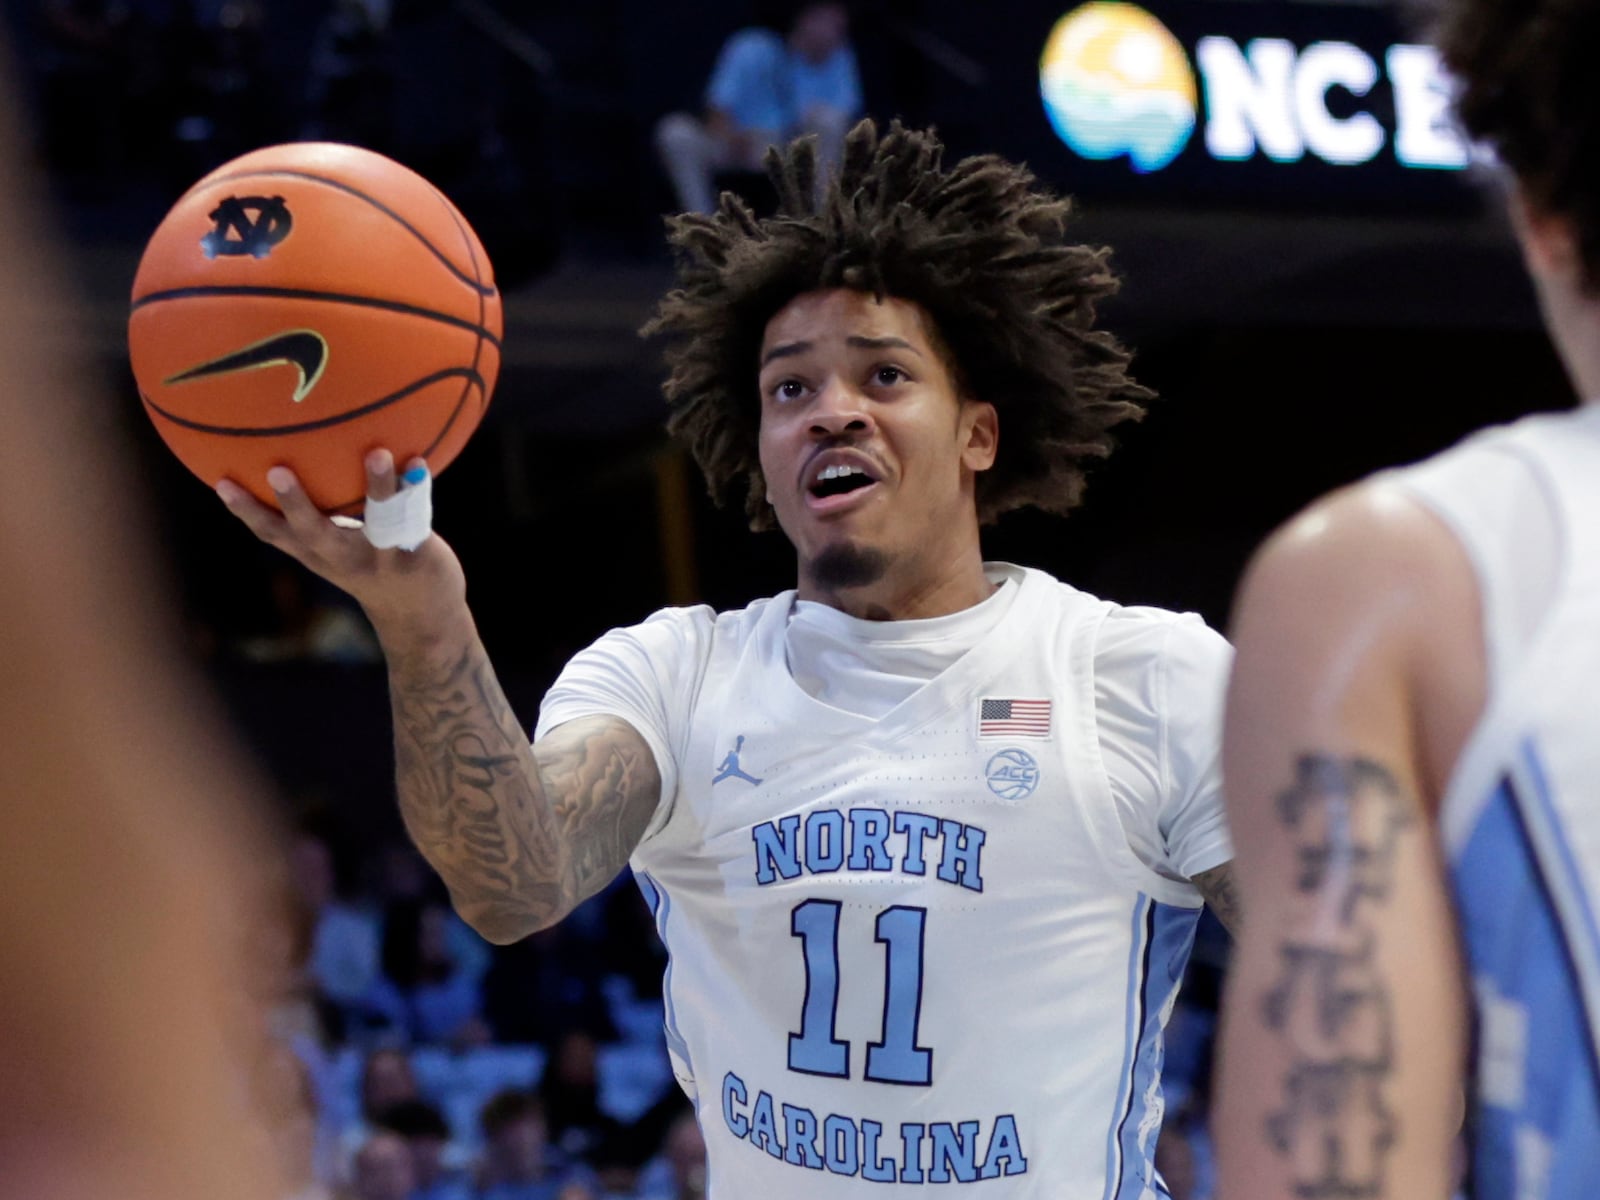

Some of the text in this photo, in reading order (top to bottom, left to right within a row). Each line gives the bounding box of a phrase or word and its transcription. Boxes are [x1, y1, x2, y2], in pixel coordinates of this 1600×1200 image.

[752, 807, 986, 893] NORTH
[787, 898, 933, 1086] 11
[721, 1070, 1028, 1185] CAROLINA
